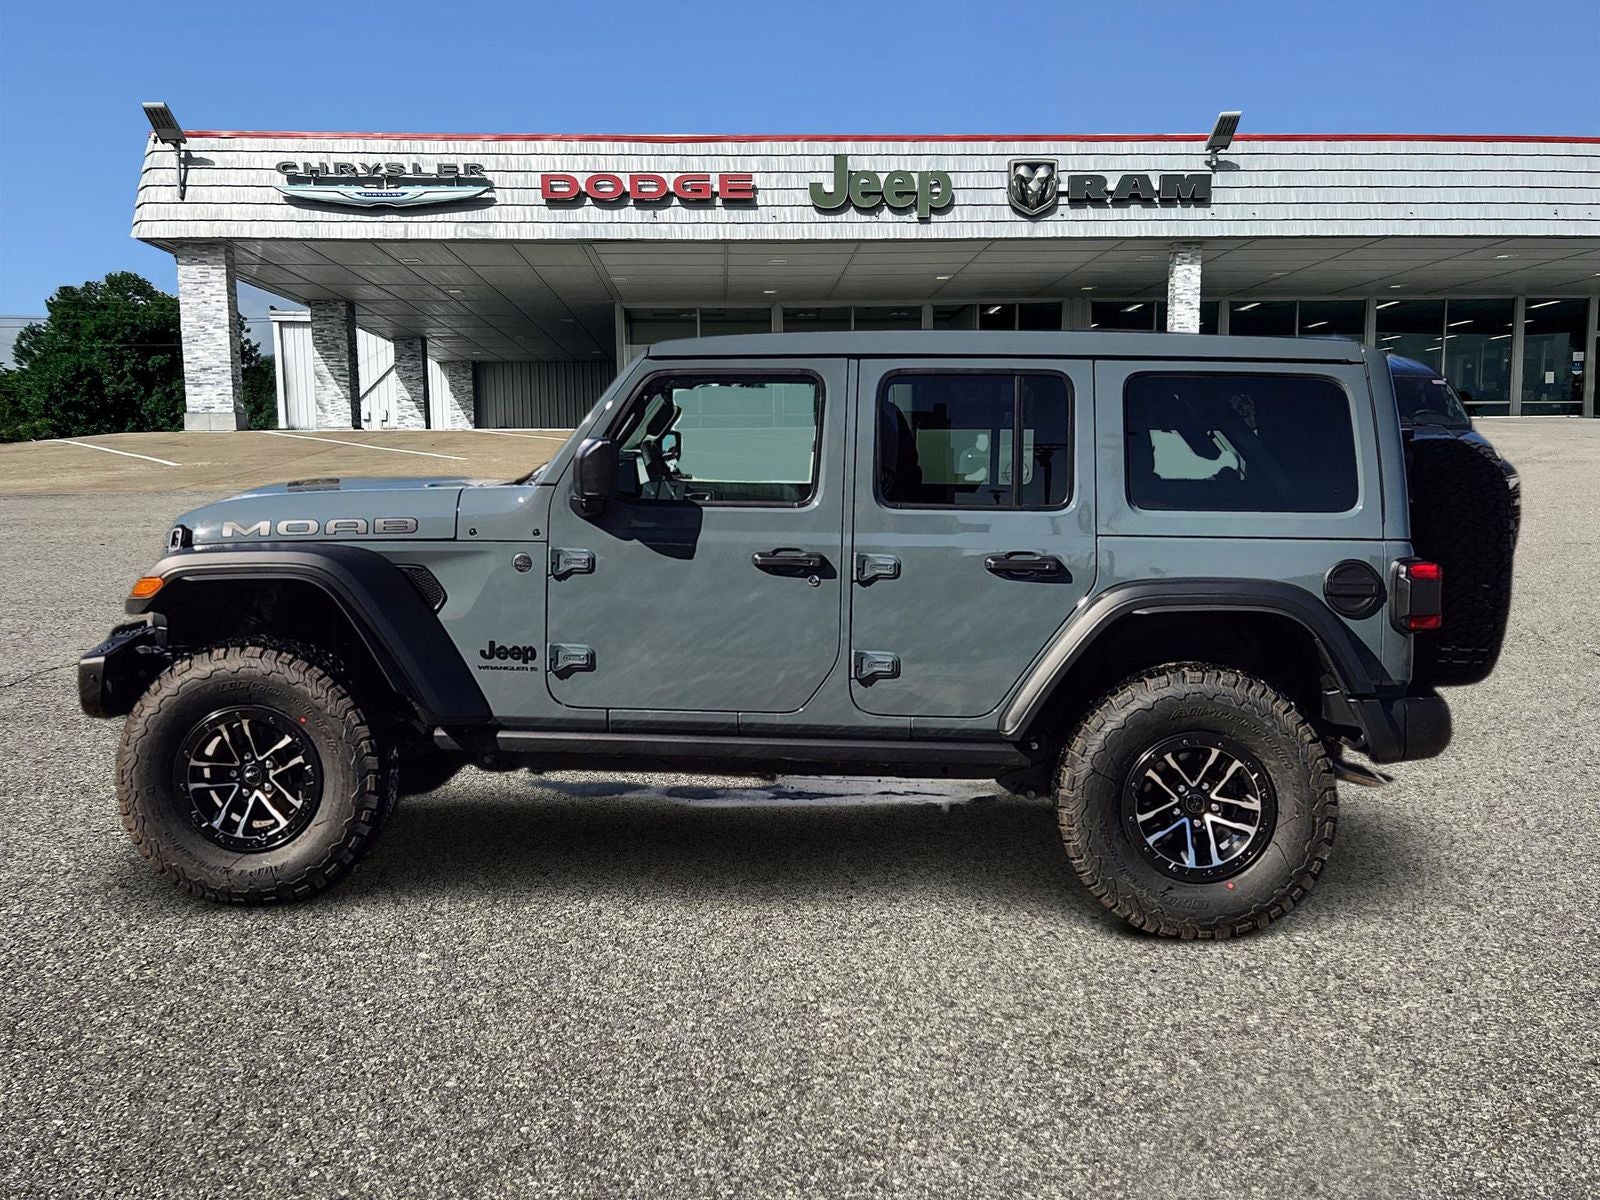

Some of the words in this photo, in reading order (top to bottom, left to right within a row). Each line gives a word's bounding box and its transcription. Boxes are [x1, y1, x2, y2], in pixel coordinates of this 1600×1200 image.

[275, 161, 486, 177] CHRYSLER
[541, 173, 755, 200] DODGE
[809, 155, 953, 218] Jeep
[1068, 174, 1212, 200] RAM
[221, 518, 418, 537] MOAB
[480, 640, 537, 664] Jeep
